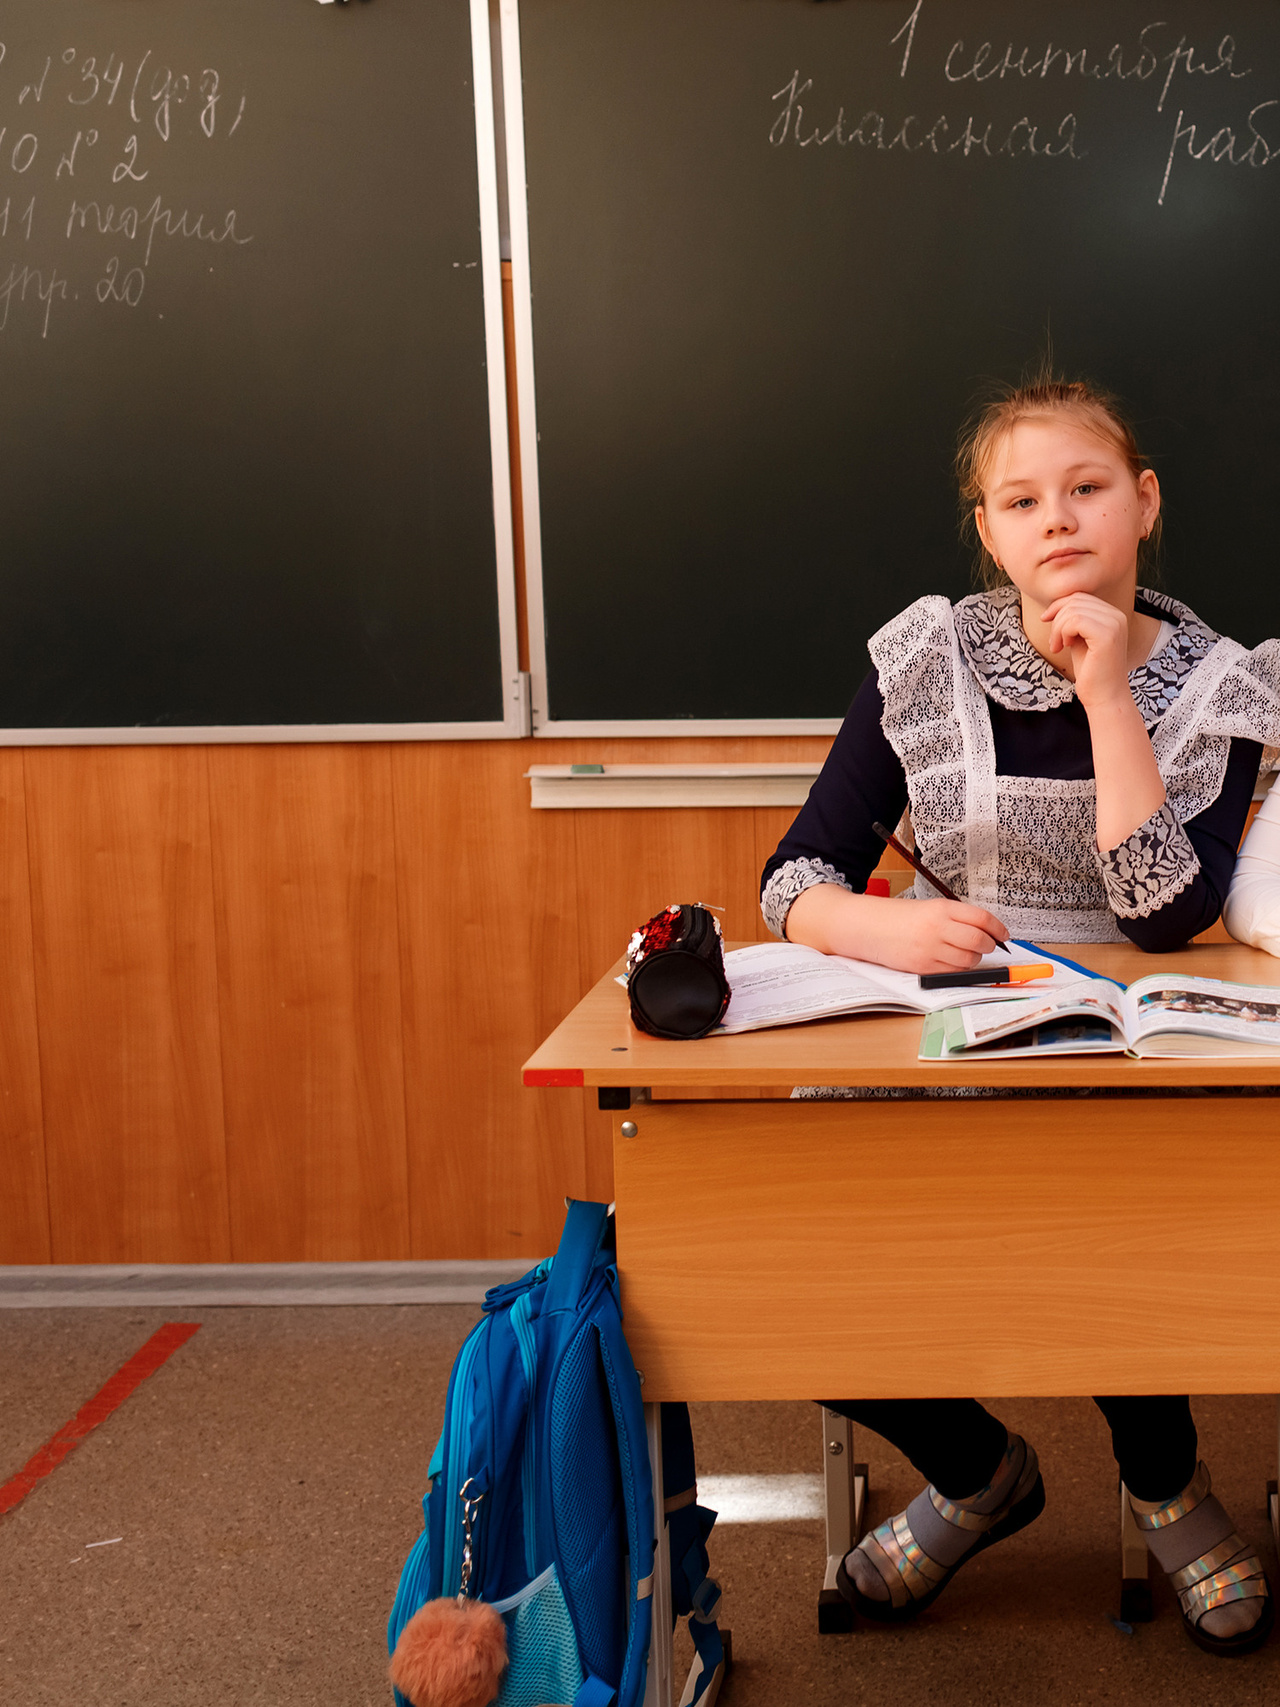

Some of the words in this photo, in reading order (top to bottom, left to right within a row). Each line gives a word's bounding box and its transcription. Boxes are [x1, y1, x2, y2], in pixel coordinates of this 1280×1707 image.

[890, 0, 923, 79] 1
[945, 21, 1252, 112] сентября
[768, 69, 1088, 161] Классная
[112, 134, 149, 184] 2
[65, 195, 254, 266] теория
[96, 256, 146, 307] 20
